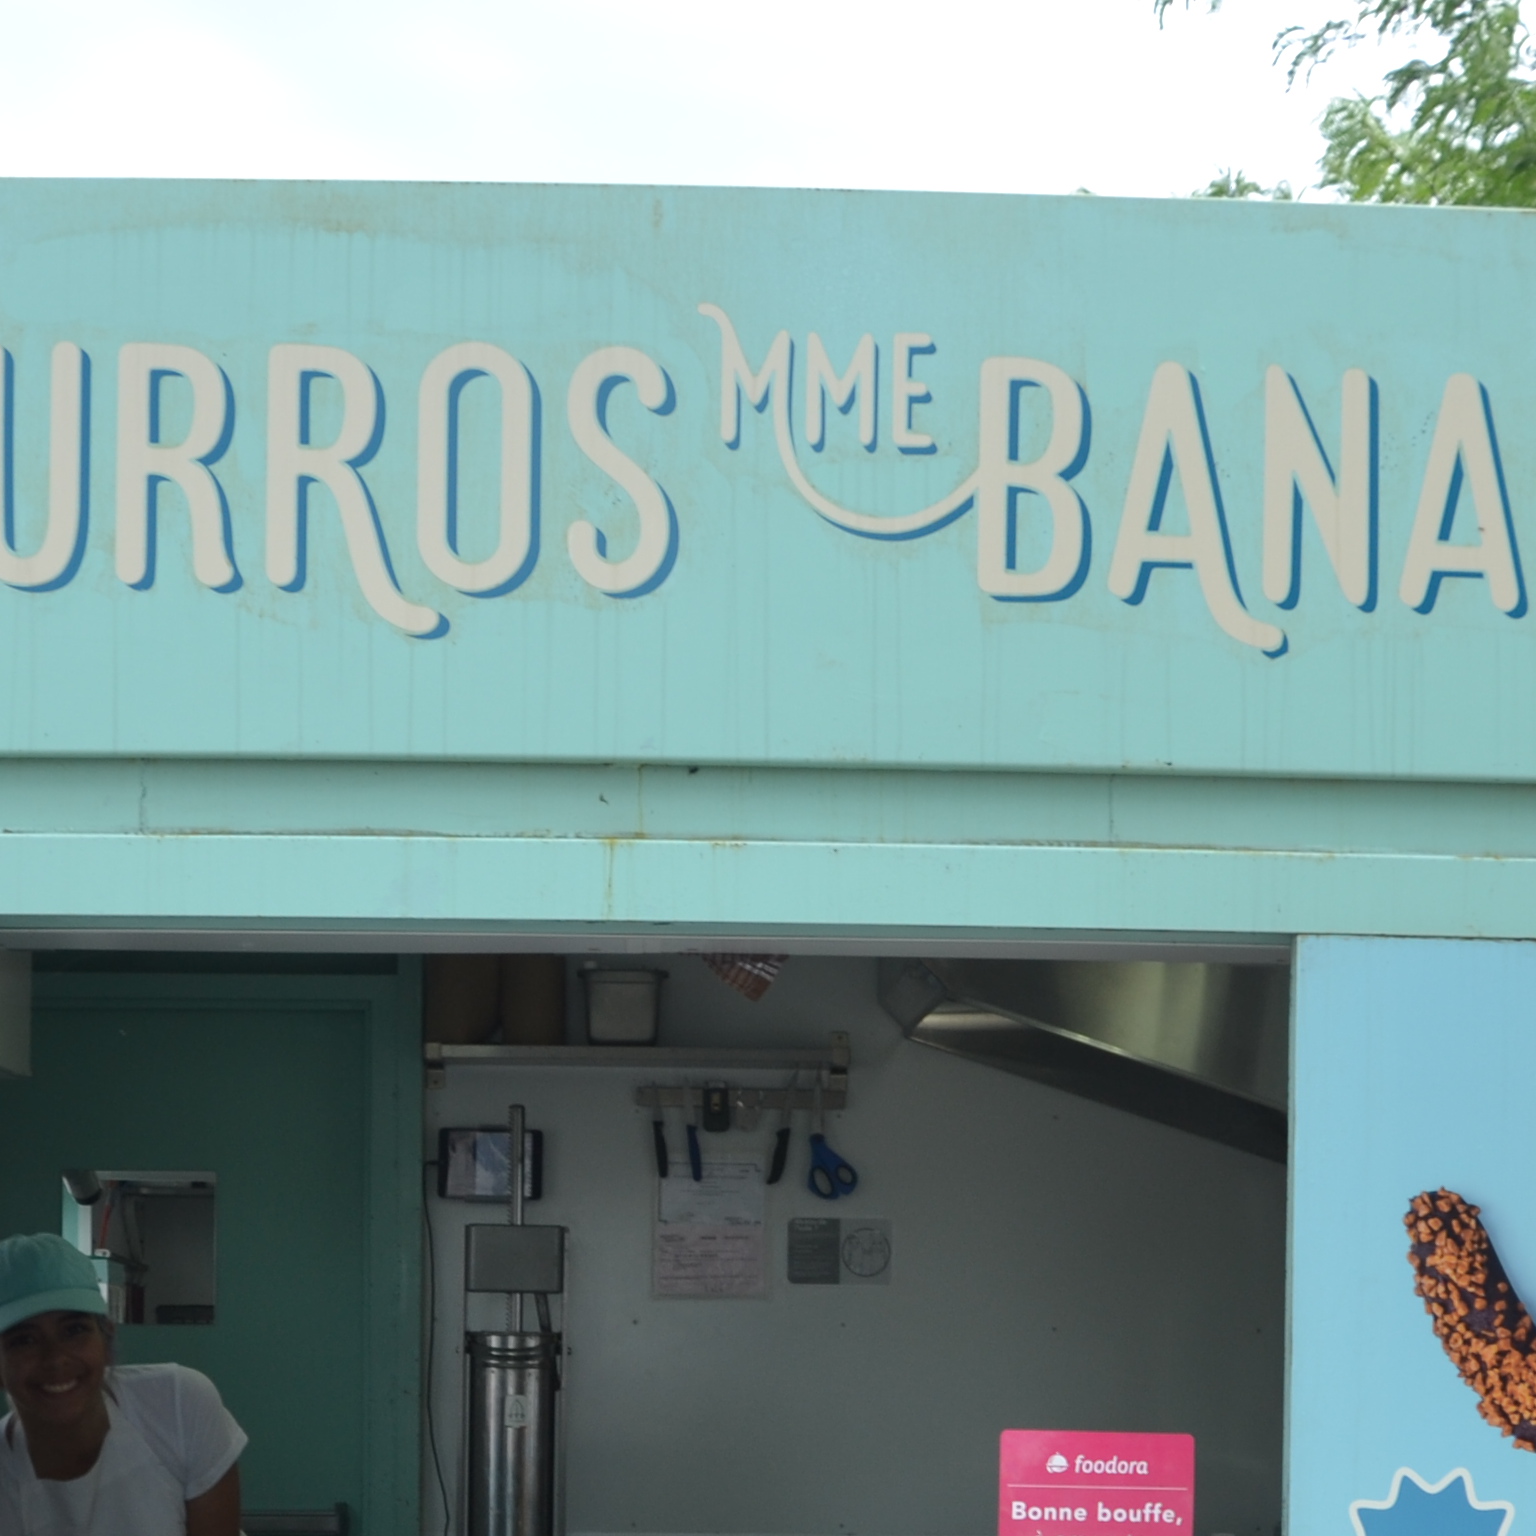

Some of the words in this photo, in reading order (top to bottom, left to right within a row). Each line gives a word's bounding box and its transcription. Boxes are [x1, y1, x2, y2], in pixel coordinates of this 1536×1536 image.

[697, 301, 978, 542] MME
[1074, 1454, 1149, 1475] foodora
[1010, 1500, 1088, 1522] Bonne
[1096, 1501, 1184, 1526] bouffe,
